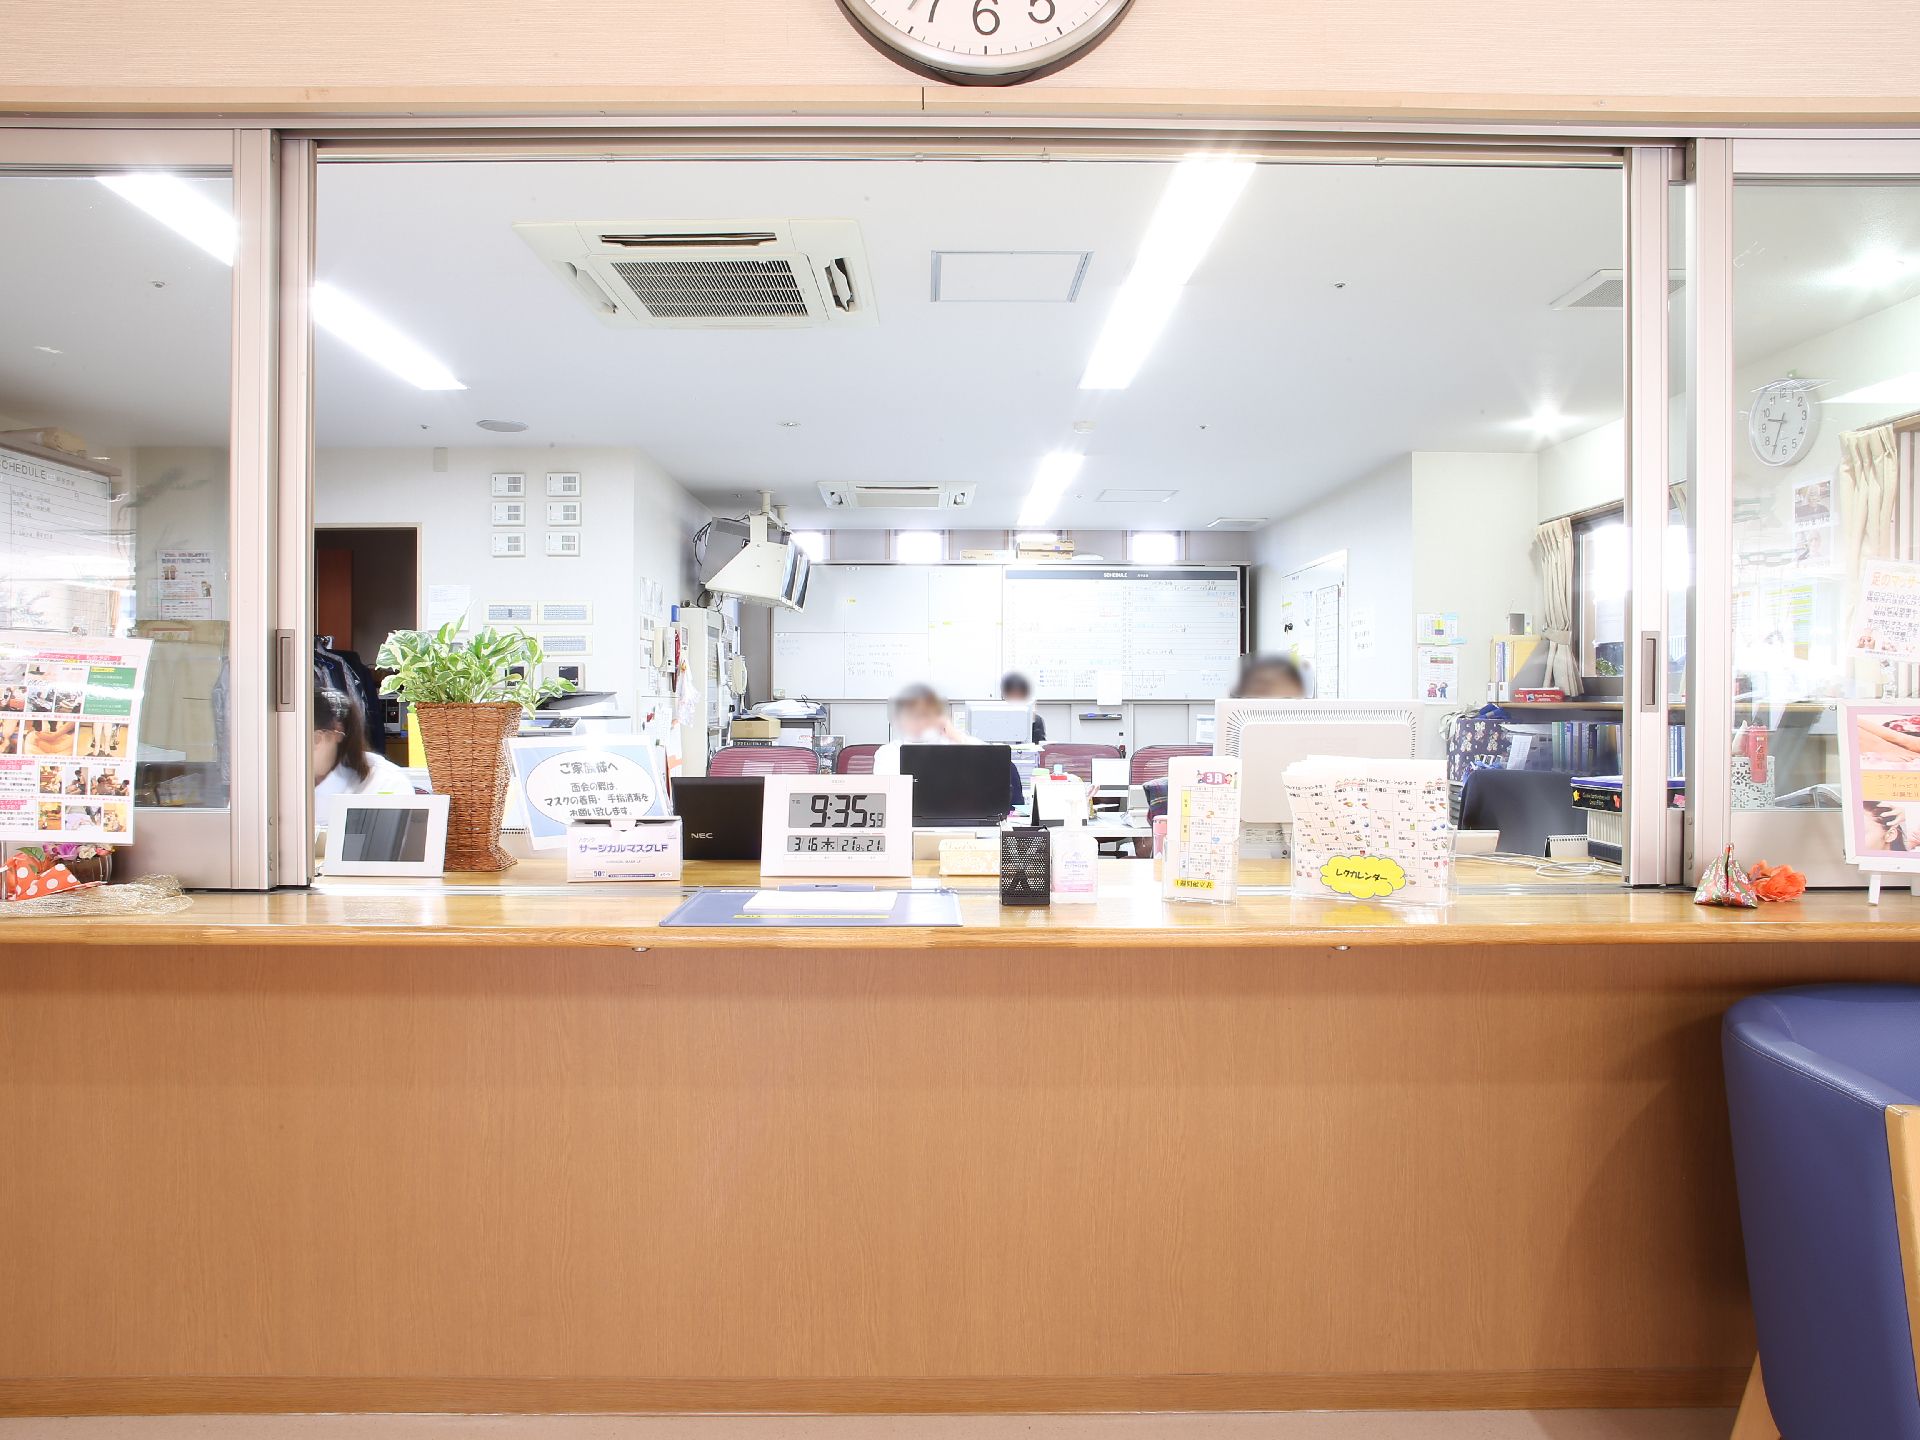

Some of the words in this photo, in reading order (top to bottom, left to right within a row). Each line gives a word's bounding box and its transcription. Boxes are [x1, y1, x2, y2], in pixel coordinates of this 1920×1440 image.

[972, 0, 1001, 36] 6
[0, 459, 46, 480] CHEDULE
[1206, 772, 1223, 784] 3月
[810, 794, 868, 828] 9:35
[1335, 868, 1388, 882] レクカレンダー
